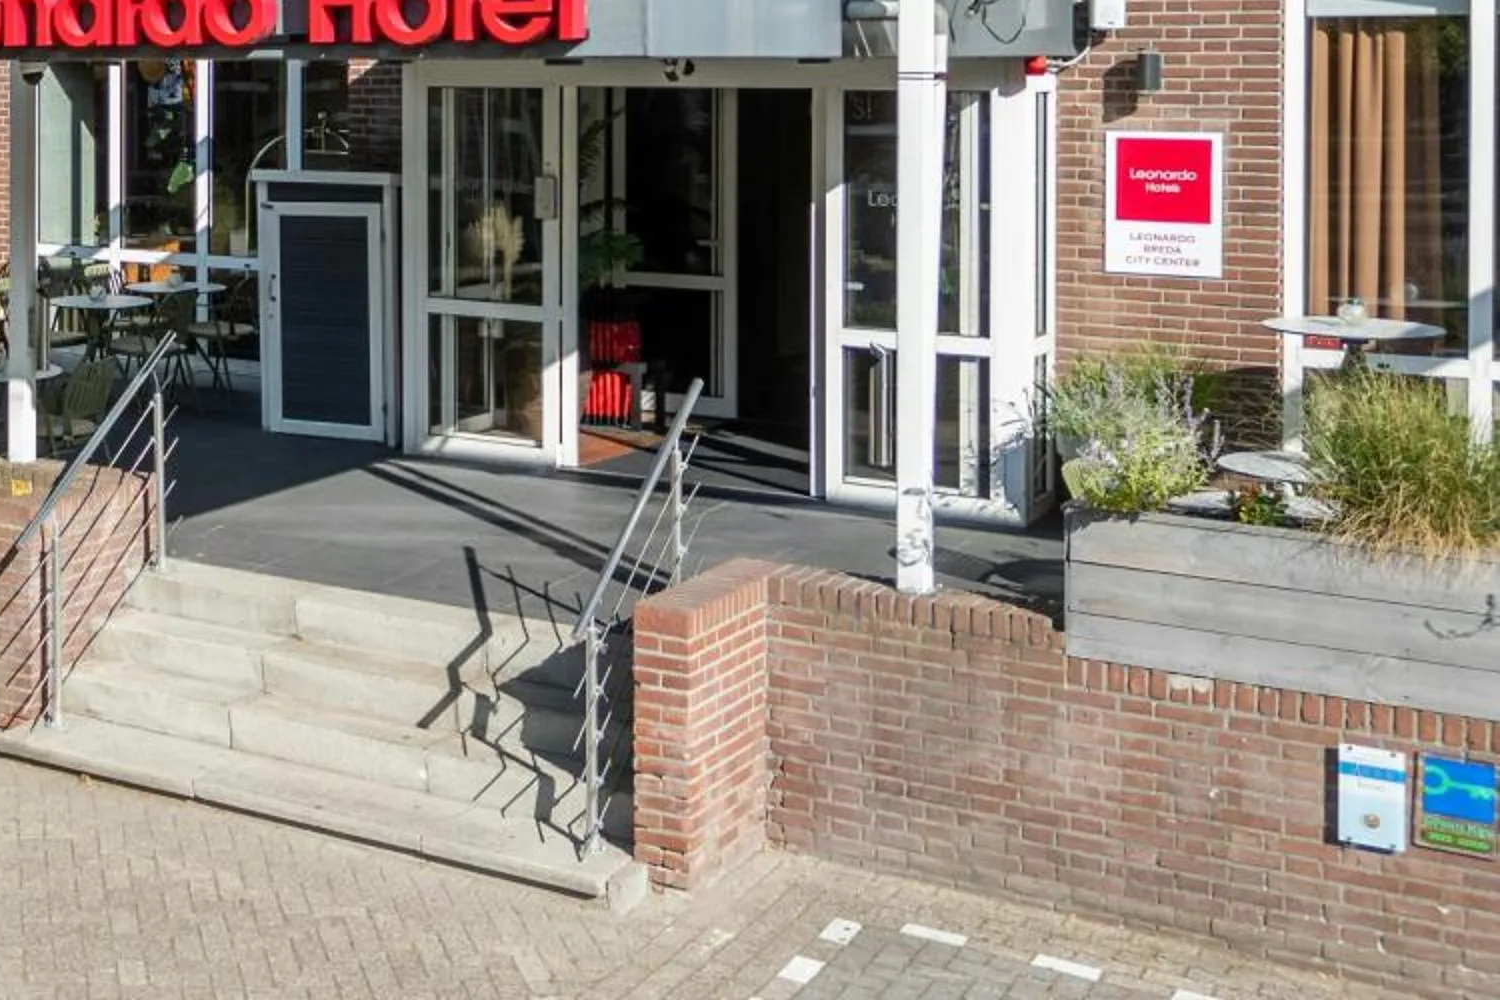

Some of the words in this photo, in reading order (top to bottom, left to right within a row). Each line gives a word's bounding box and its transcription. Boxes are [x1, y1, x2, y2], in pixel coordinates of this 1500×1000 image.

[1129, 168, 1198, 181] Leonardo
[1145, 182, 1182, 193] Hotels
[1129, 232, 1196, 244] LEONARDO
[1143, 244, 1182, 255] BREDA
[1125, 255, 1151, 265] CITY
